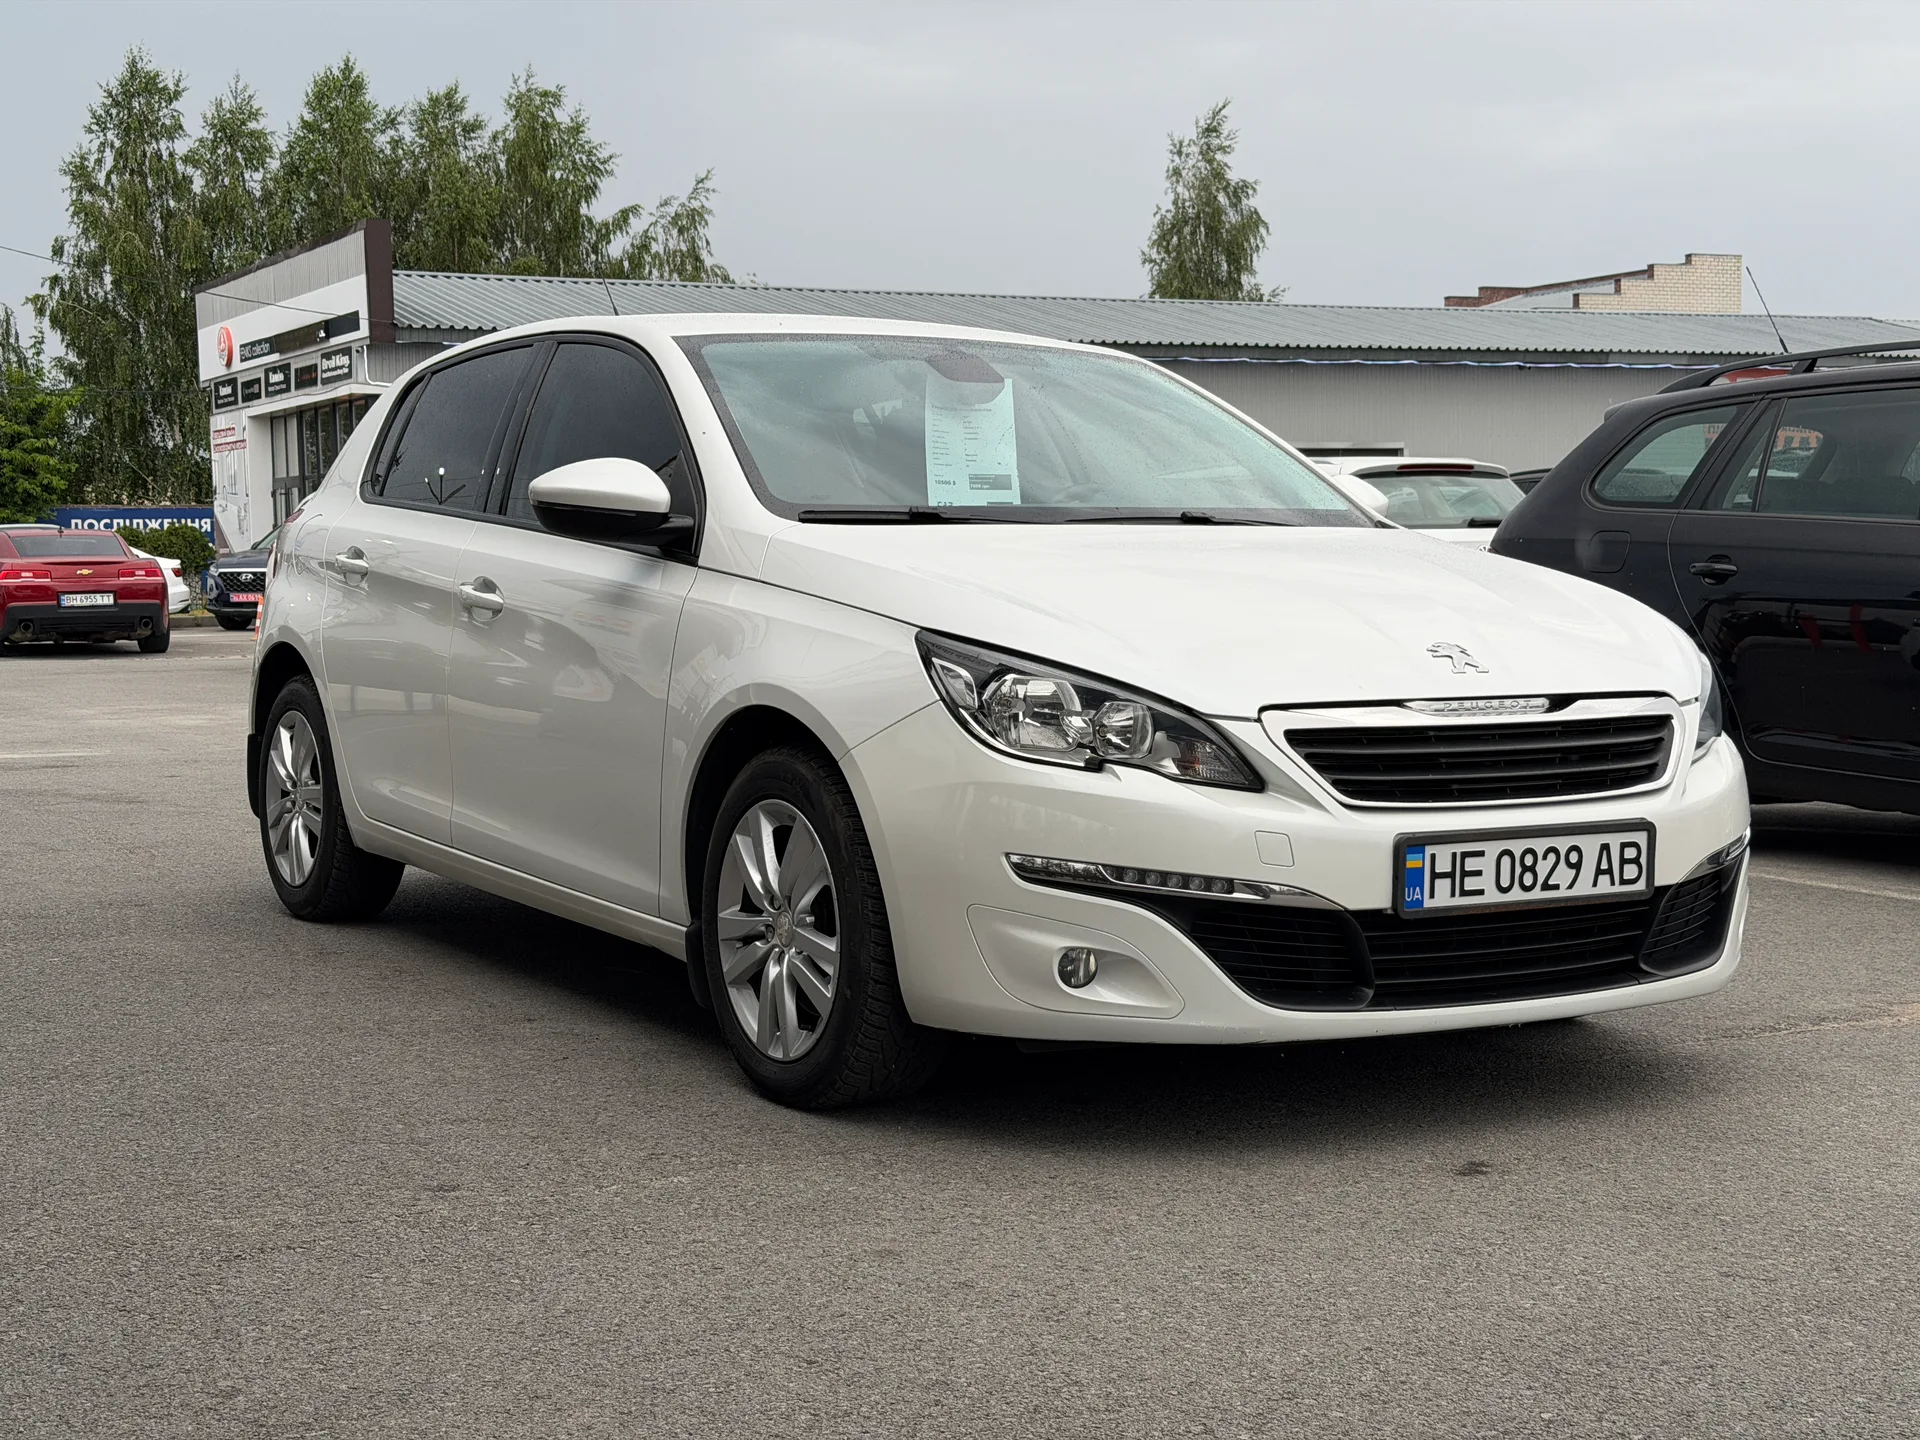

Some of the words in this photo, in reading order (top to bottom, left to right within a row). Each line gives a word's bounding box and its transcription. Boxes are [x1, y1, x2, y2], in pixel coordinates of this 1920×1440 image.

[80, 595, 98, 603] 6955
[100, 594, 112, 602] TT
[1443, 699, 1532, 712] PEUGEOT
[1428, 849, 1486, 899] HE
[1495, 844, 1583, 894] 0829
[1591, 840, 1643, 888] AB
[1404, 886, 1422, 902] UA
